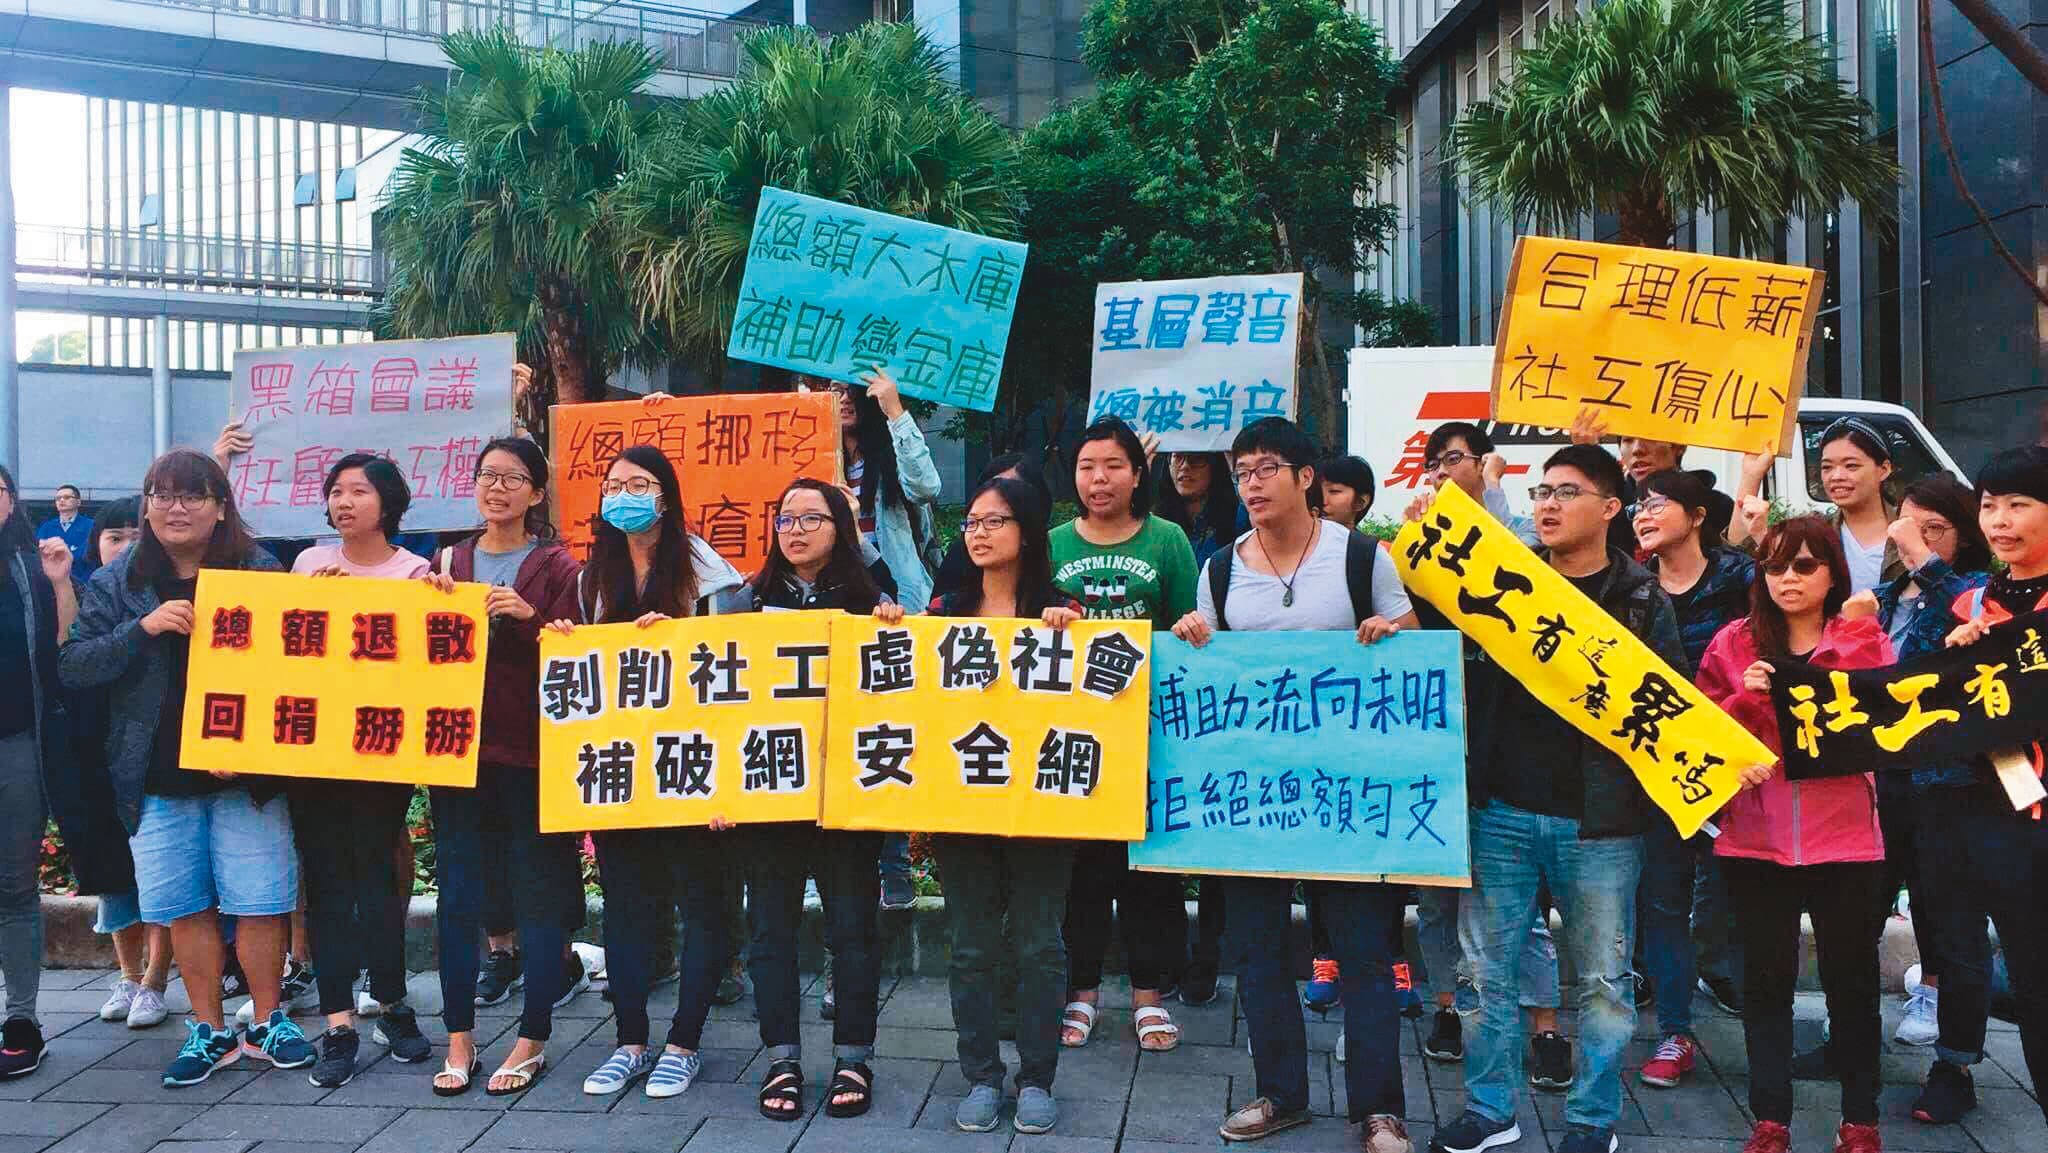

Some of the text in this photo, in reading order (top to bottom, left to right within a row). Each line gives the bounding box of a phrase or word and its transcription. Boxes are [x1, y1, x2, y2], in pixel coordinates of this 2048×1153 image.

[1099, 287, 1292, 353] 基層聲音
[1540, 252, 1807, 338] 合理低薪
[735, 287, 1001, 405] 補助變金庫
[243, 357, 478, 423] 黑箱會議
[1509, 344, 1786, 427] 社工傷心
[1055, 554, 1158, 583] WESTMINSTER
[1080, 575, 1129, 603] W
[210, 604, 477, 664] 總額退散
[1082, 599, 1146, 620] LLEGE
[543, 640, 830, 721] 剝削社工
[860, 624, 1145, 698] 虛偽社會
[1149, 665, 1448, 741] 補助流向未明
[576, 726, 806, 805] 補破網
[857, 720, 1102, 797] 安全網
